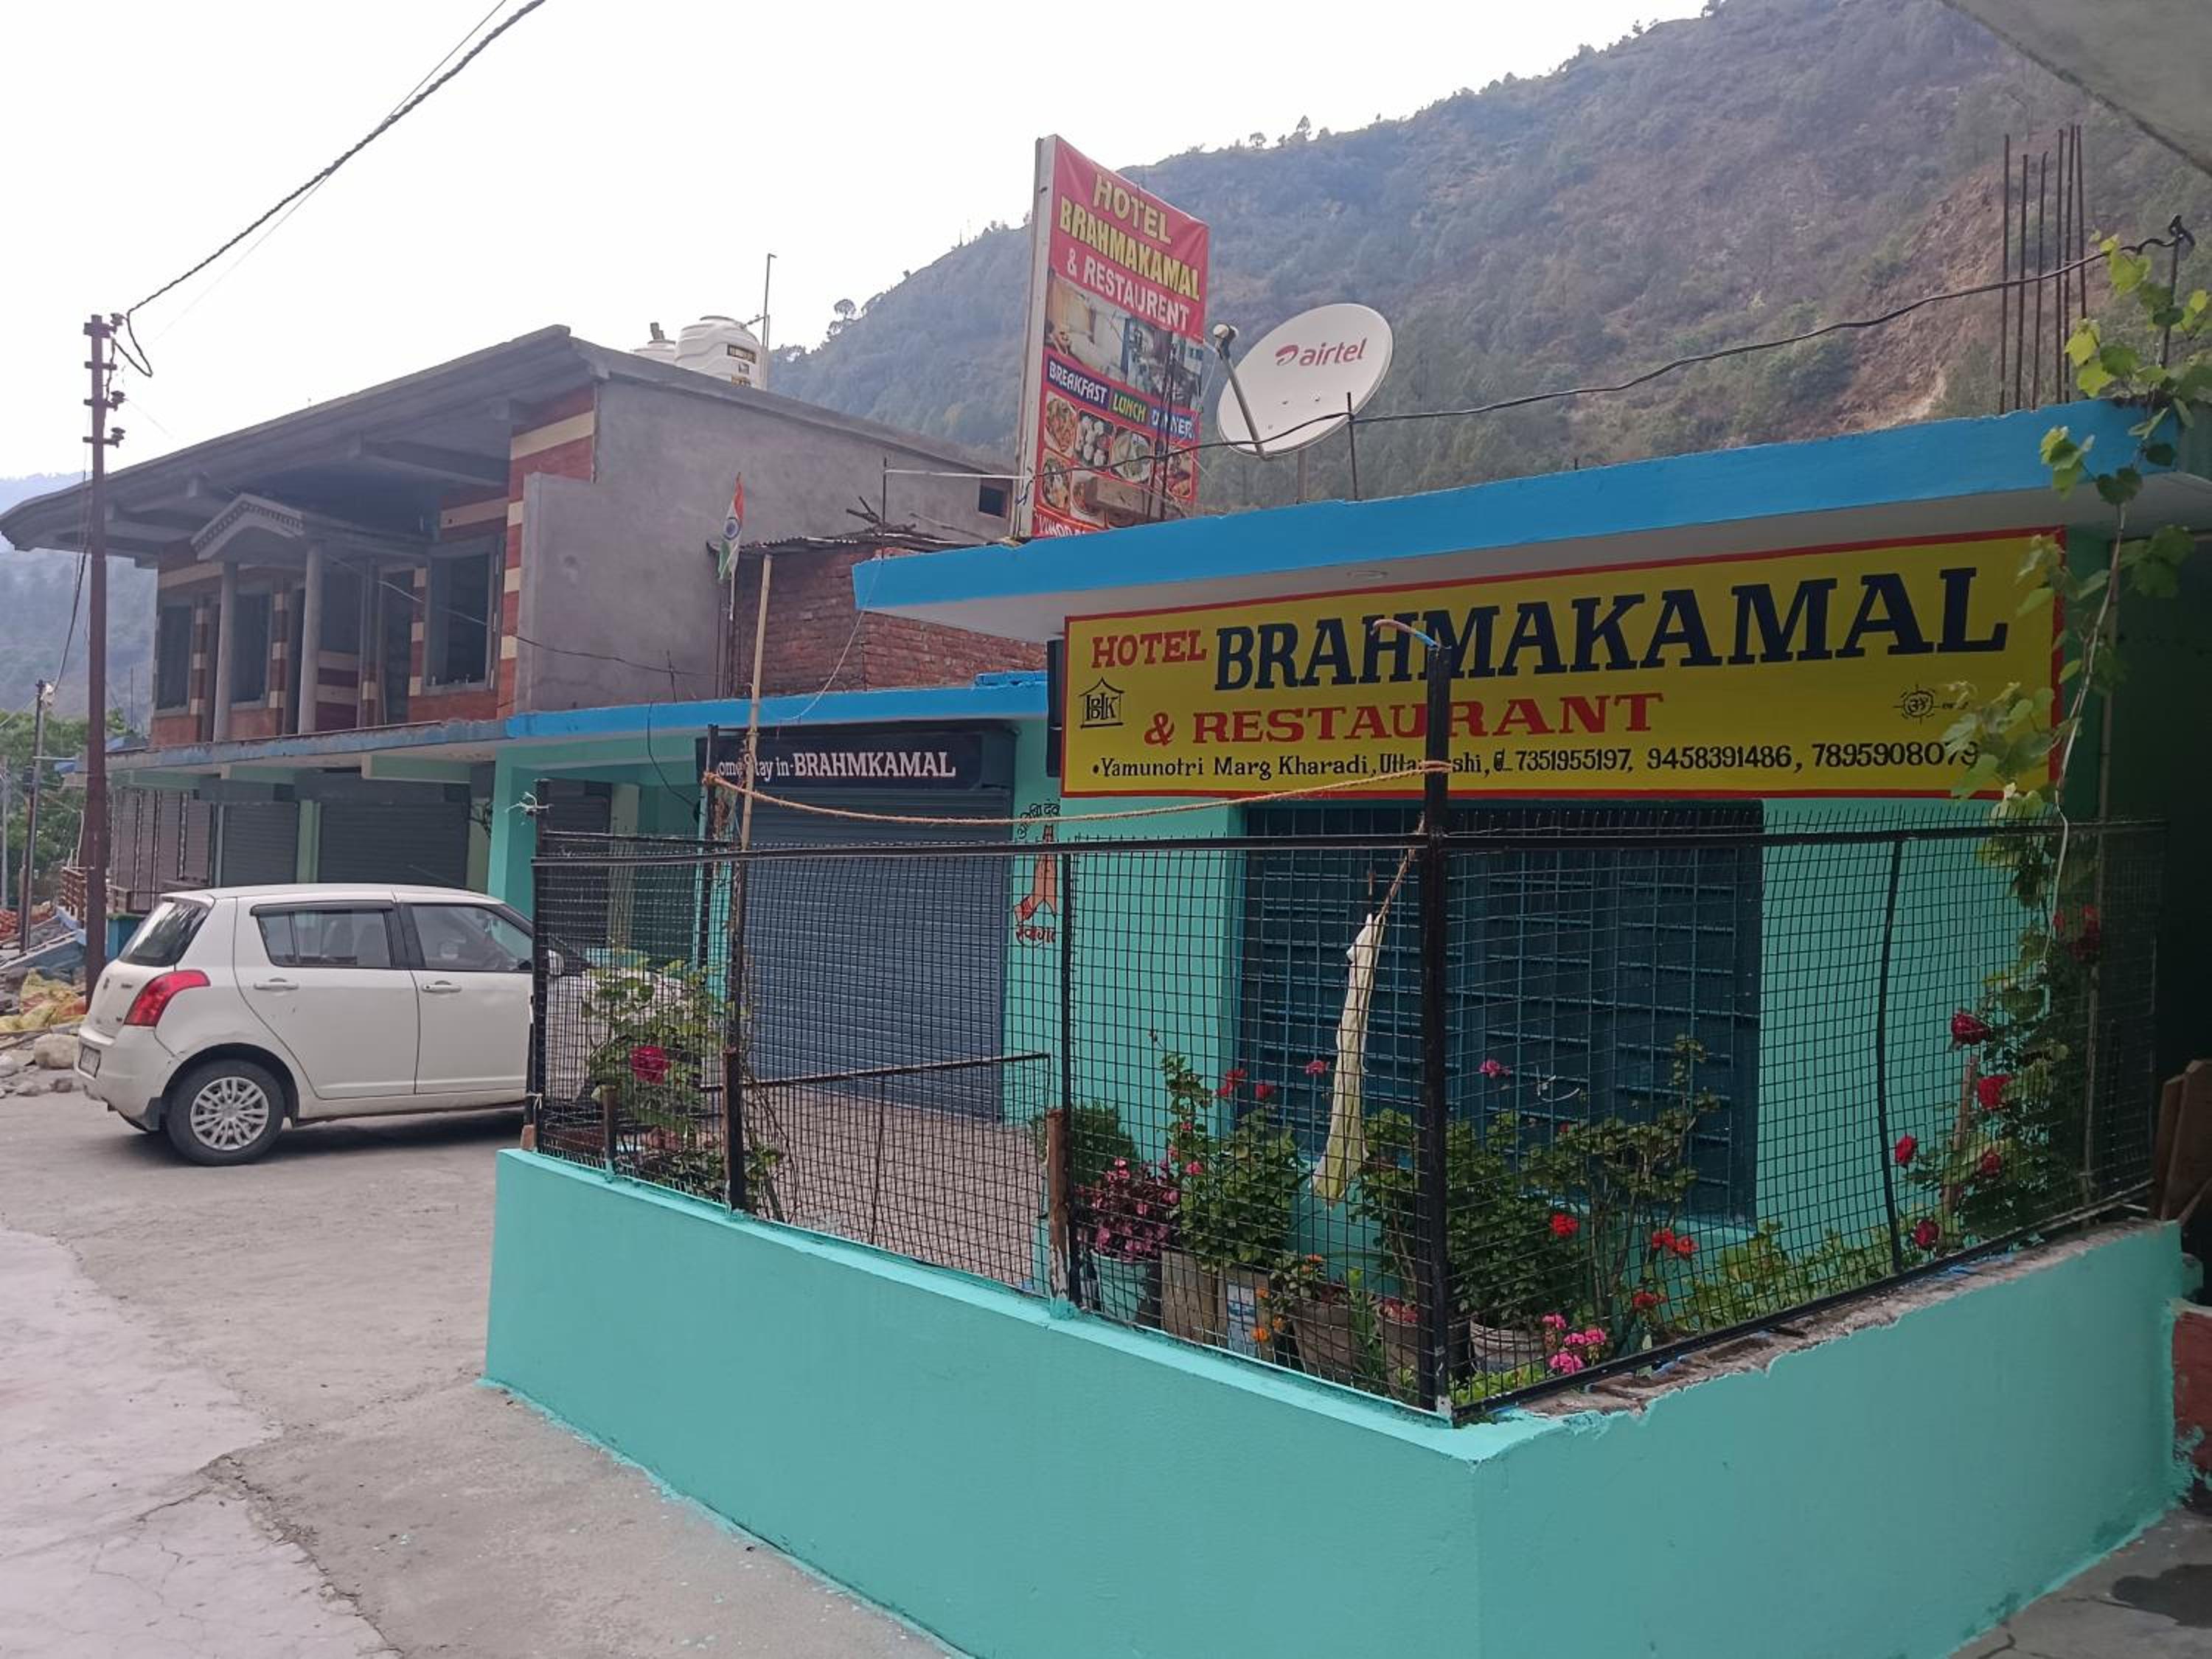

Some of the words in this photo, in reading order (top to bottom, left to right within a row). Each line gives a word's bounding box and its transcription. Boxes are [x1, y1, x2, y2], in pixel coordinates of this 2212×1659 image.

[1093, 174, 1171, 244] HOTEL
[1060, 195, 1200, 301] BRAHMAKAMAL
[1068, 249, 1078, 277] &
[1084, 256, 1189, 331] RESTAURENT
[1299, 337, 1367, 366] airtel
[1049, 361, 1107, 404] BREAKFAST
[1113, 394, 1147, 422] LUNCH
[1091, 630, 1208, 669] HOTEL
[1214, 567, 2008, 692] BRAHMAKAMAL
[1144, 712, 1175, 745] &
[1193, 692, 1663, 745] RESTAURANT
[1100, 757, 1203, 777] Yamunotri
[1214, 757, 1272, 781] Marg
[1380, 752, 1490, 778] Uttashi,
[1516, 748, 1632, 773] 7351955197,
[1646, 745, 1803, 774] 9458391486,
